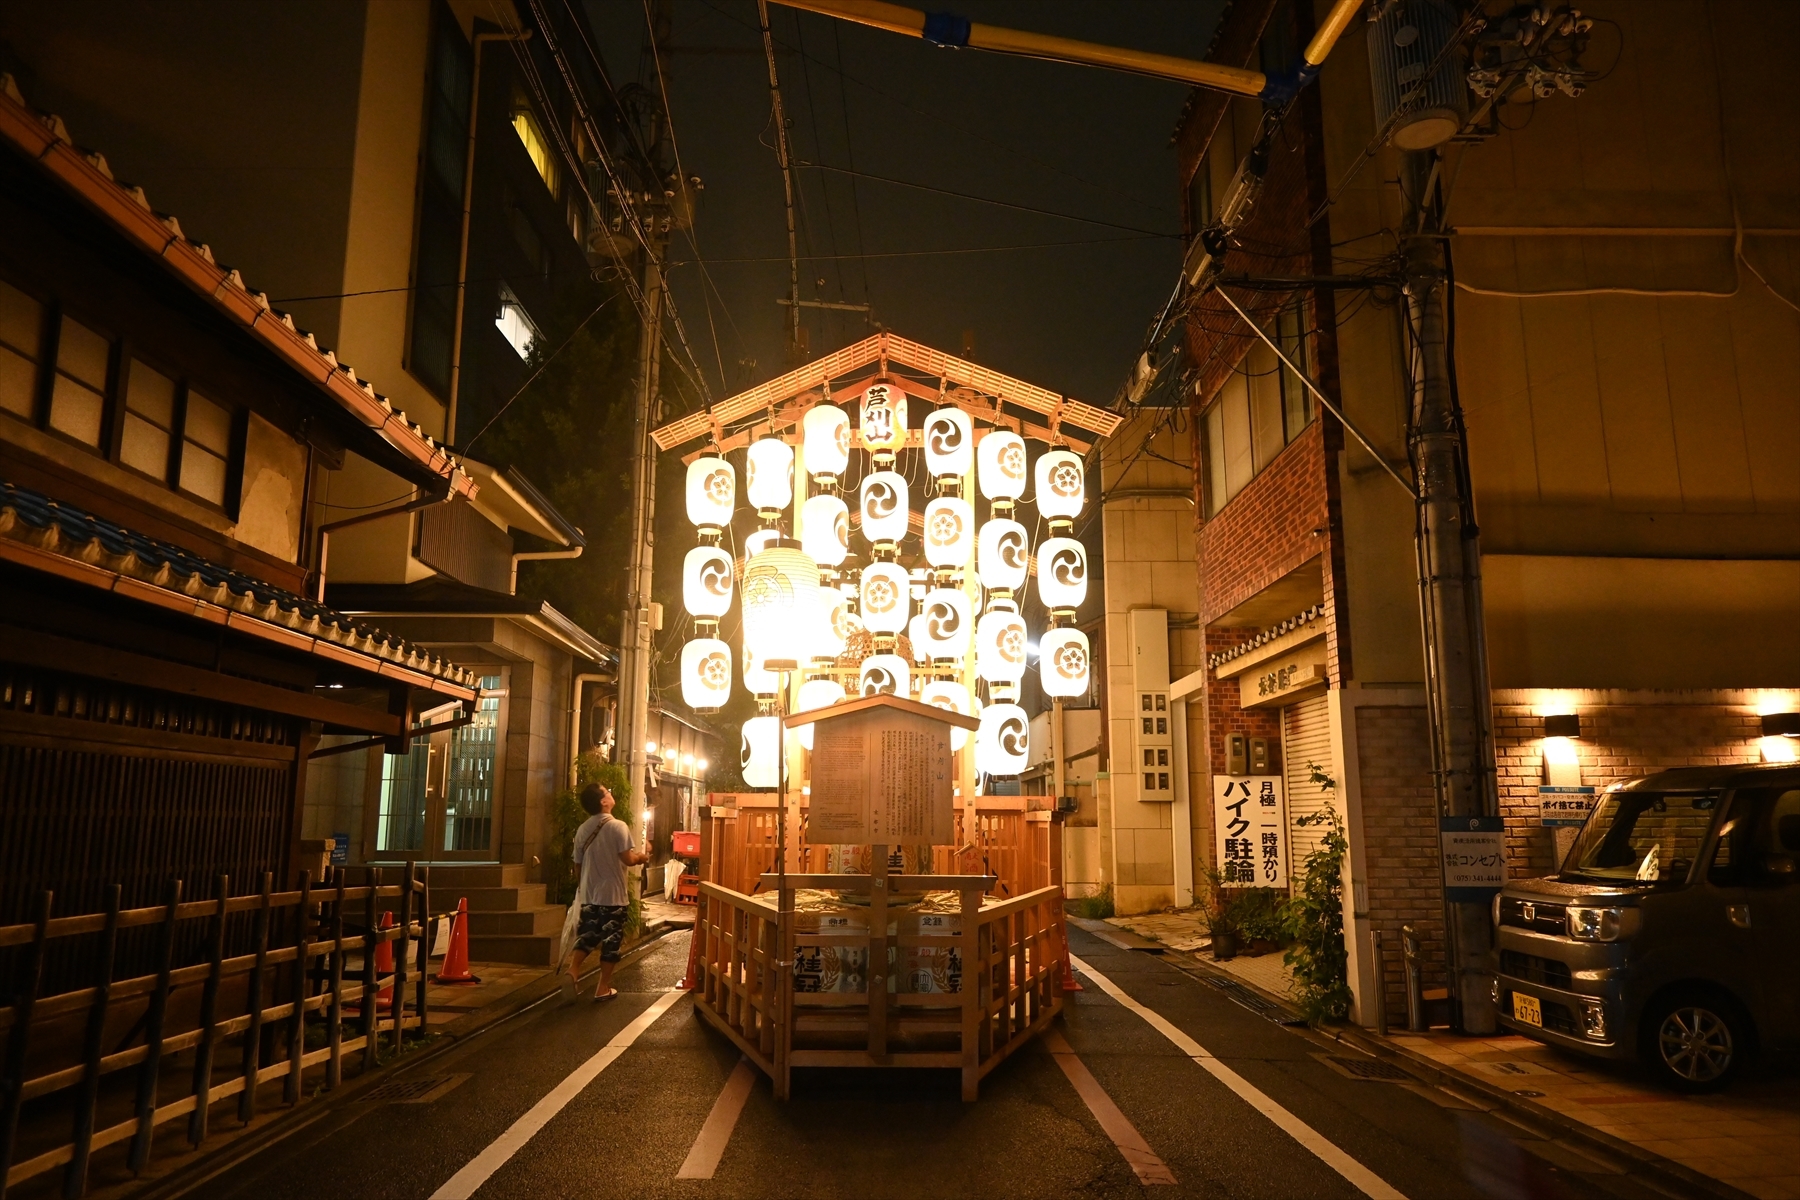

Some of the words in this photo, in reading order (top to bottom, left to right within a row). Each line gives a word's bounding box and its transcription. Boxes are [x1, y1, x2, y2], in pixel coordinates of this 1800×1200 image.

[865, 387, 892, 442] 芦刈山
[1259, 782, 1276, 807] 月極
[1542, 801, 1593, 810] ポイ捨て禁止
[1223, 780, 1254, 883] バイク駐輪
[1261, 824, 1278, 882] 一時預かり
[1459, 853, 1505, 867] コンセプト
[1520, 1005, 1540, 1024] 67-23
